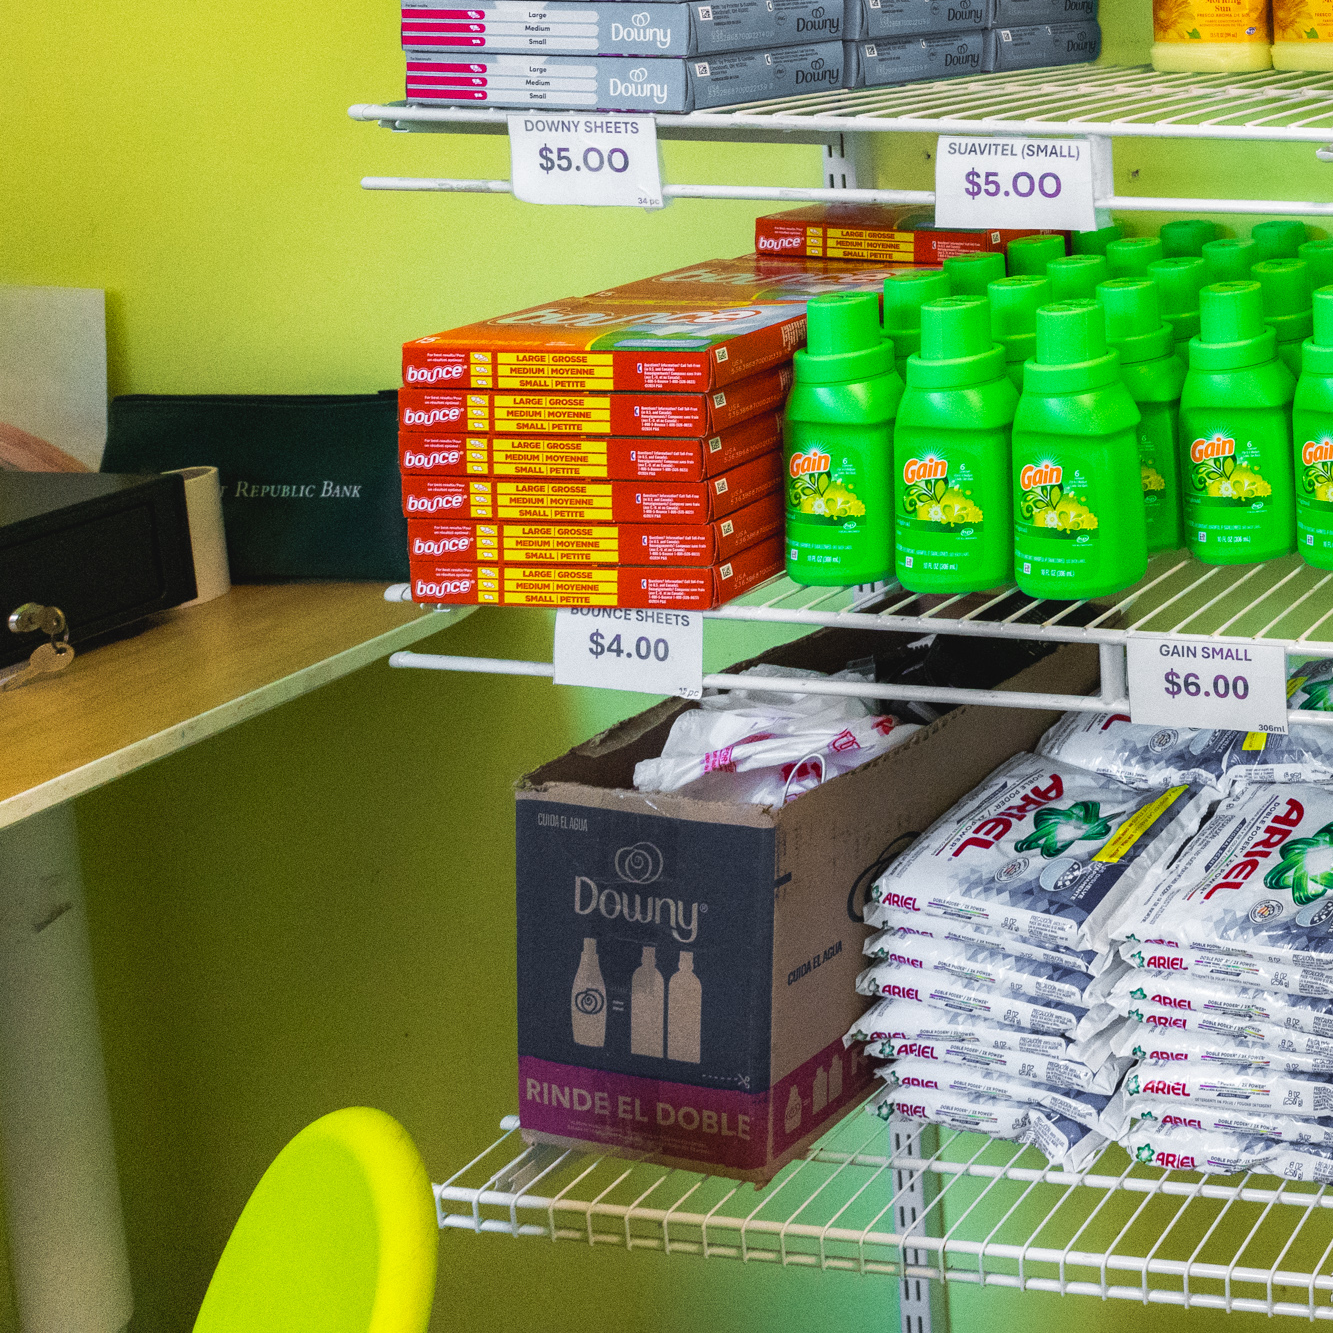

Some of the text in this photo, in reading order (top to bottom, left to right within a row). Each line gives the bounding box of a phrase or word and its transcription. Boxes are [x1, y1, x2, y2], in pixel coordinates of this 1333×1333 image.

[611, 20, 671, 49] Downy
[524, 120, 639, 134] DOWNY SHEETS
[538, 144, 630, 173] $5.00
[948, 142, 1080, 161] SUAVITEL (SMALL)
[964, 168, 1062, 200] $5.00
[649, 199, 659, 207] pc
[759, 236, 801, 250] bounce
[516, 354, 588, 363] LARGE GROSSE
[407, 364, 463, 383] bounce
[510, 367, 595, 376] MEDIUM MOYENNE
[519, 379, 585, 388] SMALL PETITE
[404, 407, 459, 426] bounce
[1191, 437, 1234, 462] Gain
[790, 451, 831, 477] Gain
[1020, 463, 1062, 490] Gain
[571, 608, 690, 626] BOUNCE SHEETS
[589, 629, 669, 662] $4.00
[1159, 644, 1252, 662] GAIN SMALL
[1164, 669, 1250, 700] $6.00
[1258, 723, 1285, 733] 306ml
[538, 813, 588, 831] CUIDA EL AGUA
[953, 774, 1064, 857] ARIEL
[1218, 798, 1304, 898] ARIEL
[574, 876, 698, 943] Downy
[882, 893, 920, 911] ARIEL
[1147, 956, 1188, 970] ARIEL
[526, 1078, 609, 1114] RINDE
[617, 1096, 648, 1122] EL
[657, 1102, 750, 1140] DOBLE
